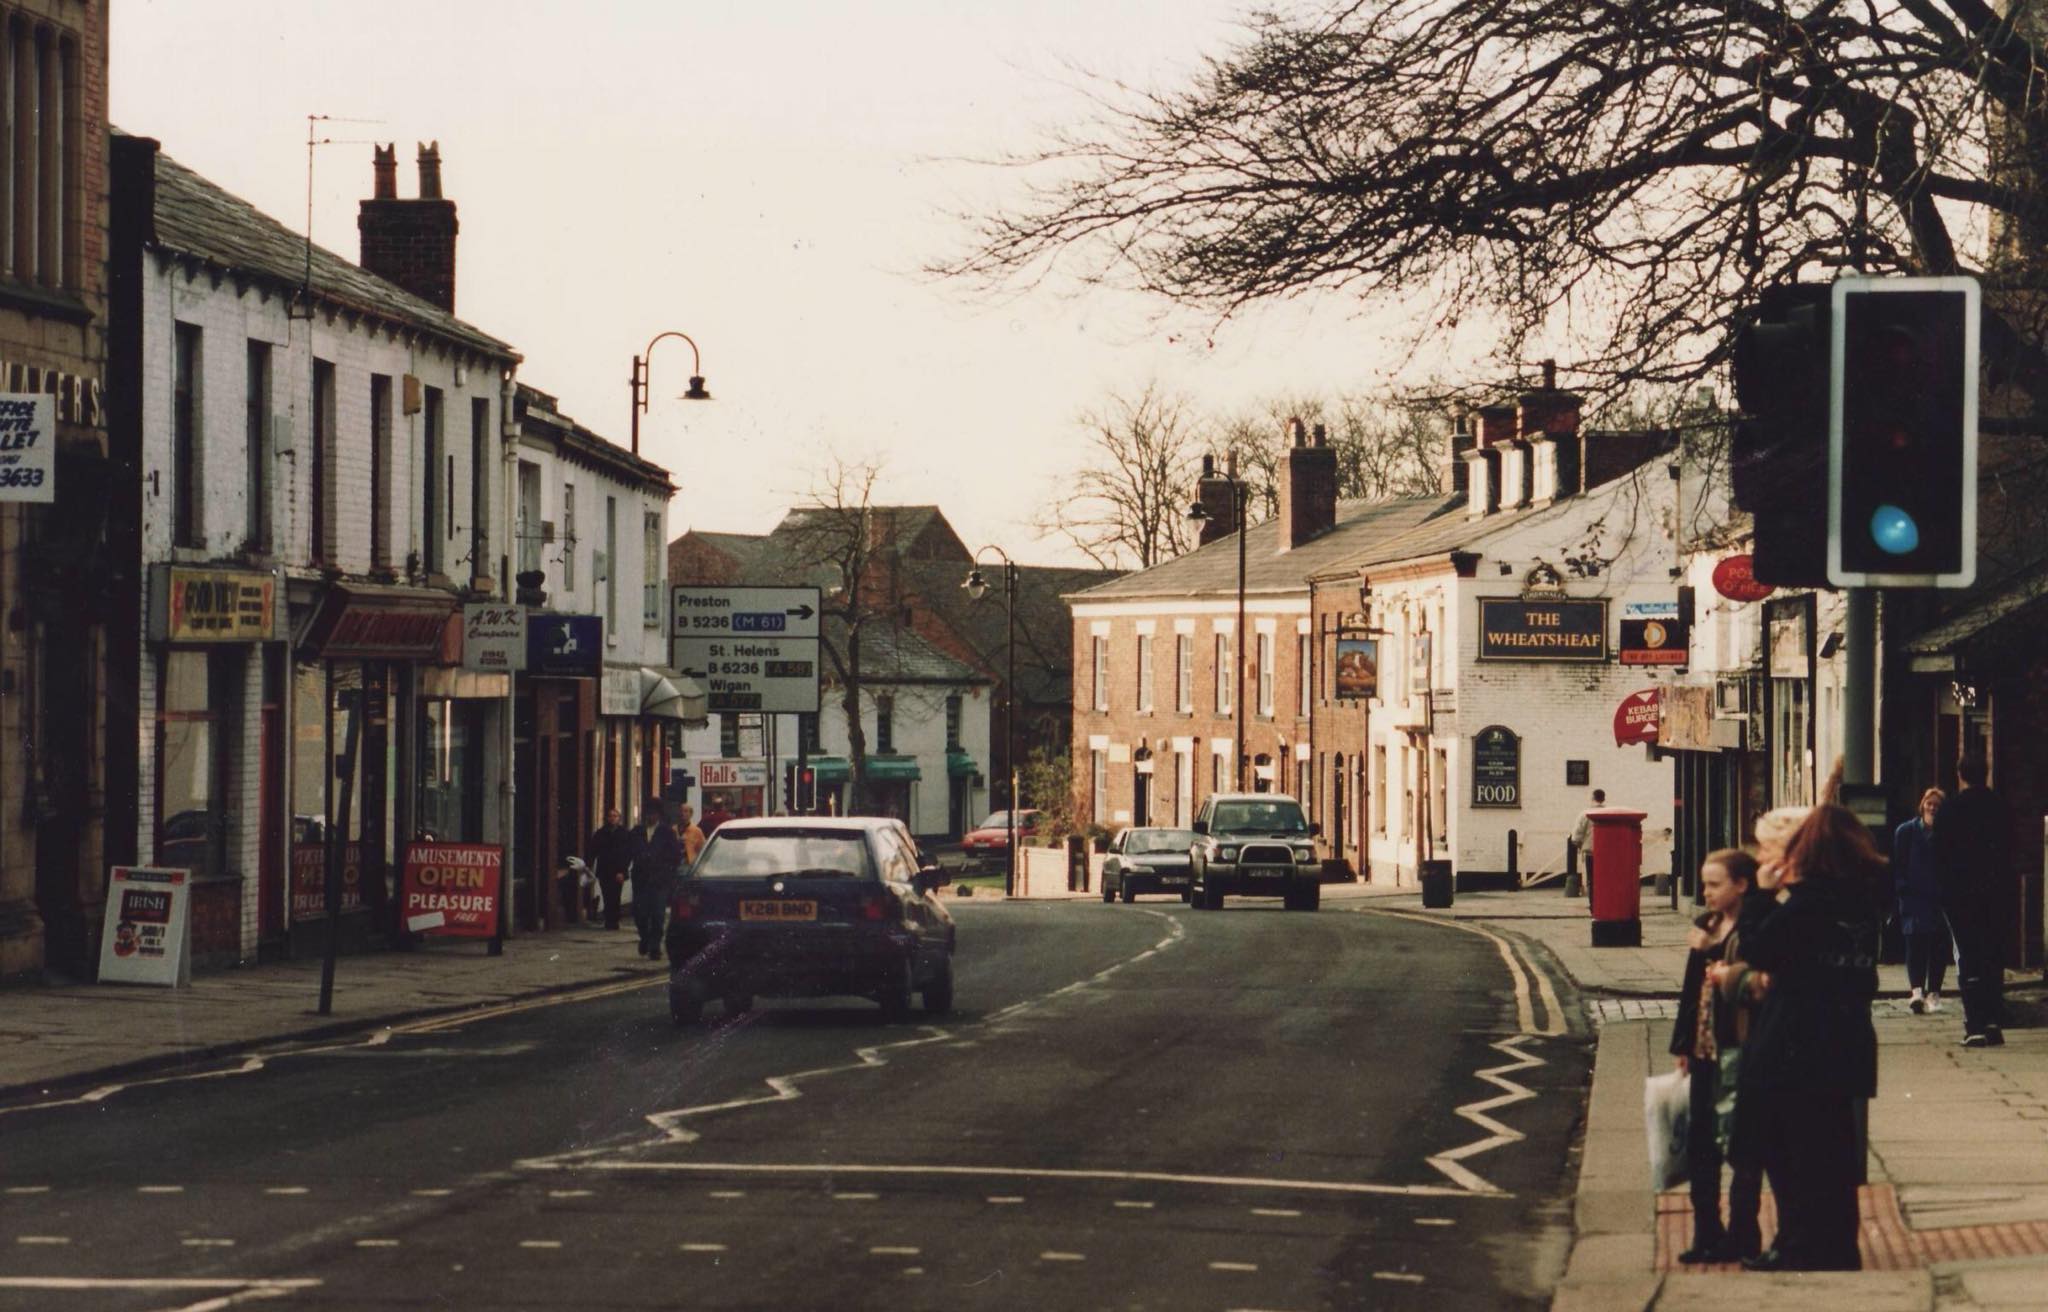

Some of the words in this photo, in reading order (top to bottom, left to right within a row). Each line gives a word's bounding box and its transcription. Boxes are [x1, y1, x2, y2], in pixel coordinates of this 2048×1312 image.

[1, 431, 40, 451] LET
[678, 595, 730, 607] Preston
[678, 616, 688, 627] B
[693, 616, 729, 627] 5236
[735, 616, 755, 629] (M
[761, 616, 783, 629] 61)
[1525, 612, 1561, 626] THE
[1487, 632, 1601, 647] WHEATSHEAF
[709, 645, 730, 656] St.
[734, 645, 780, 656] Helens
[709, 663, 717, 674] B
[709, 680, 751, 693] Wigan
[1625, 713, 1658, 725] BURGE
[703, 765, 737, 783] Hall's
[1477, 784, 1516, 802] FOOD
[408, 848, 500, 867] AMUSEMENTS
[418, 866, 485, 888] OPEN
[129, 895, 165, 910] IRISH
[408, 892, 493, 912] PLEASURE
[453, 912, 479, 922] FREE
